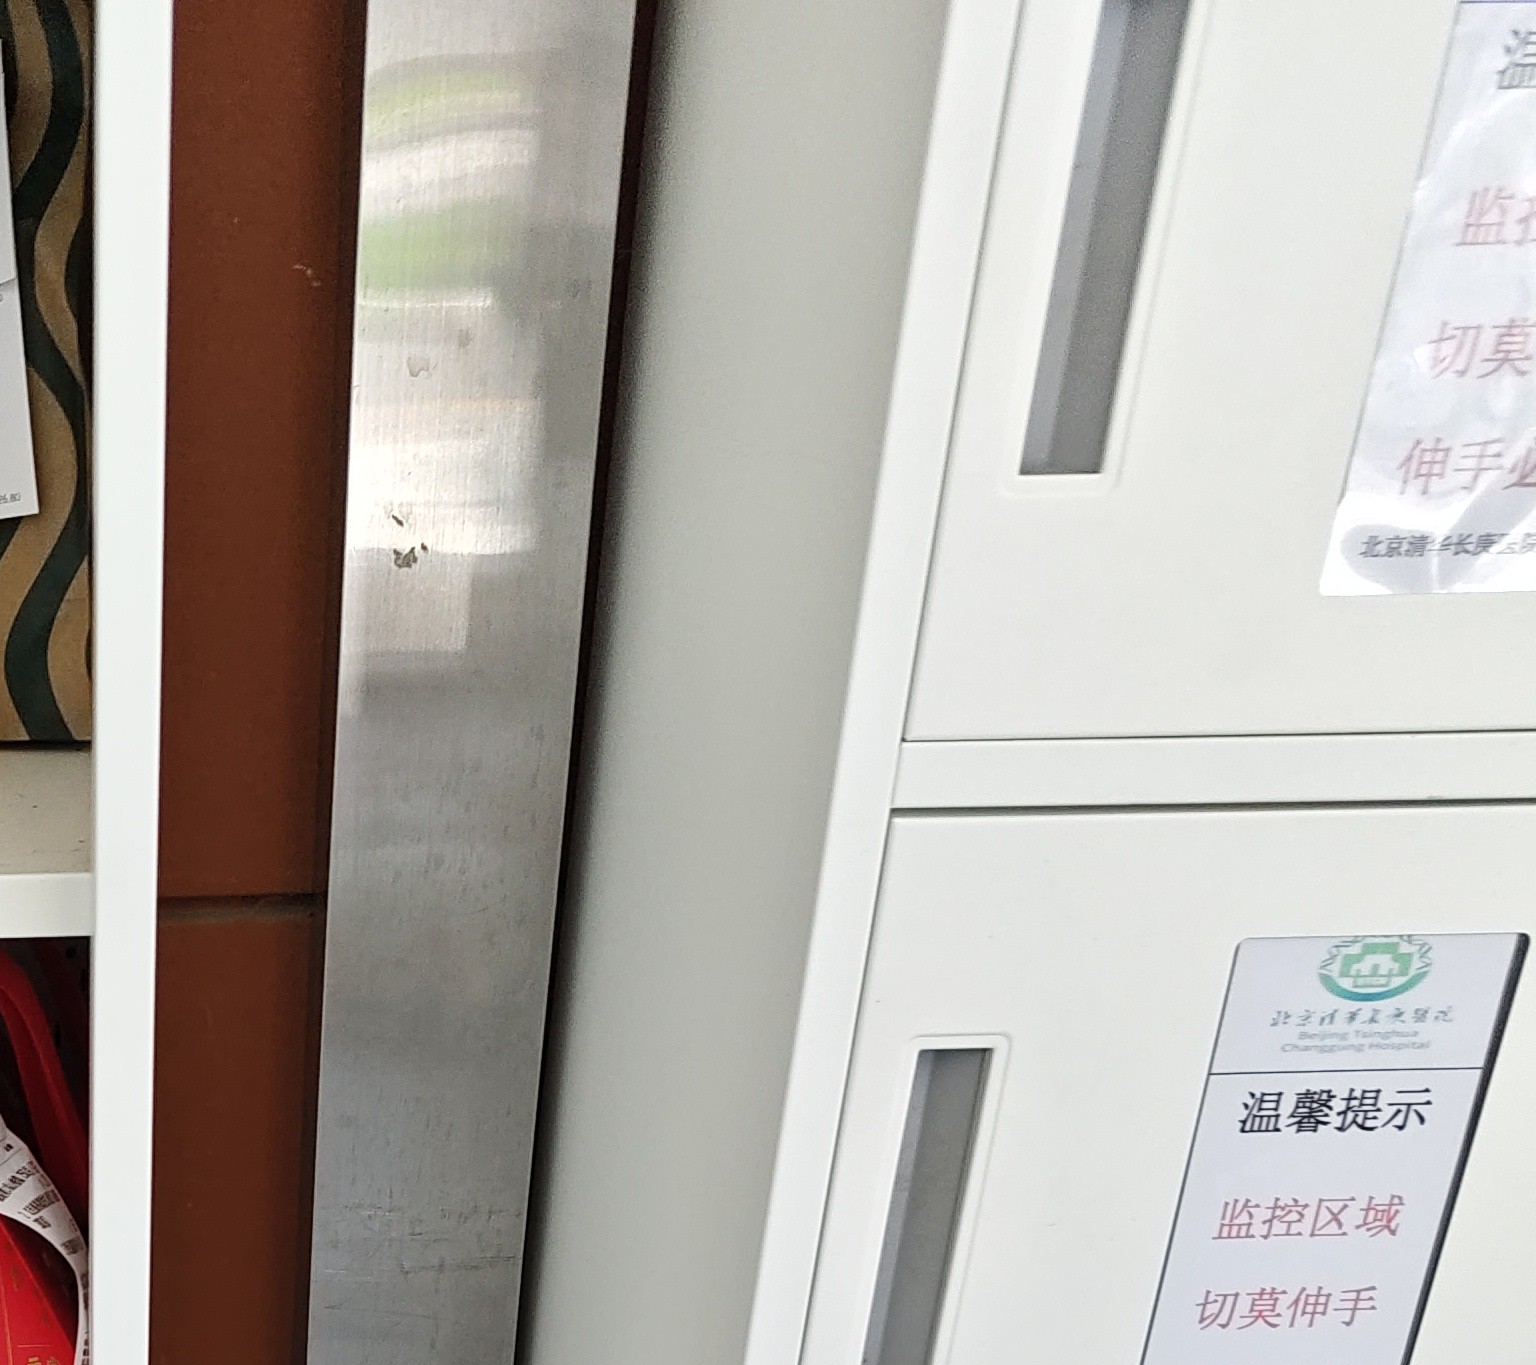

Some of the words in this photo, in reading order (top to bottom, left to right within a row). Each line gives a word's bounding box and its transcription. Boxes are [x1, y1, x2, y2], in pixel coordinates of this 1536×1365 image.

[1298, 1031, 1348, 1042] Beijing
[1353, 1029, 1419, 1040] Tsinghua
[1368, 1039, 1431, 1052] Hospital
[1238, 1088, 1433, 1134] 温馨提示
[1213, 1195, 1405, 1241] 监控区域
[1194, 1286, 1377, 1330] 切莫伸手
